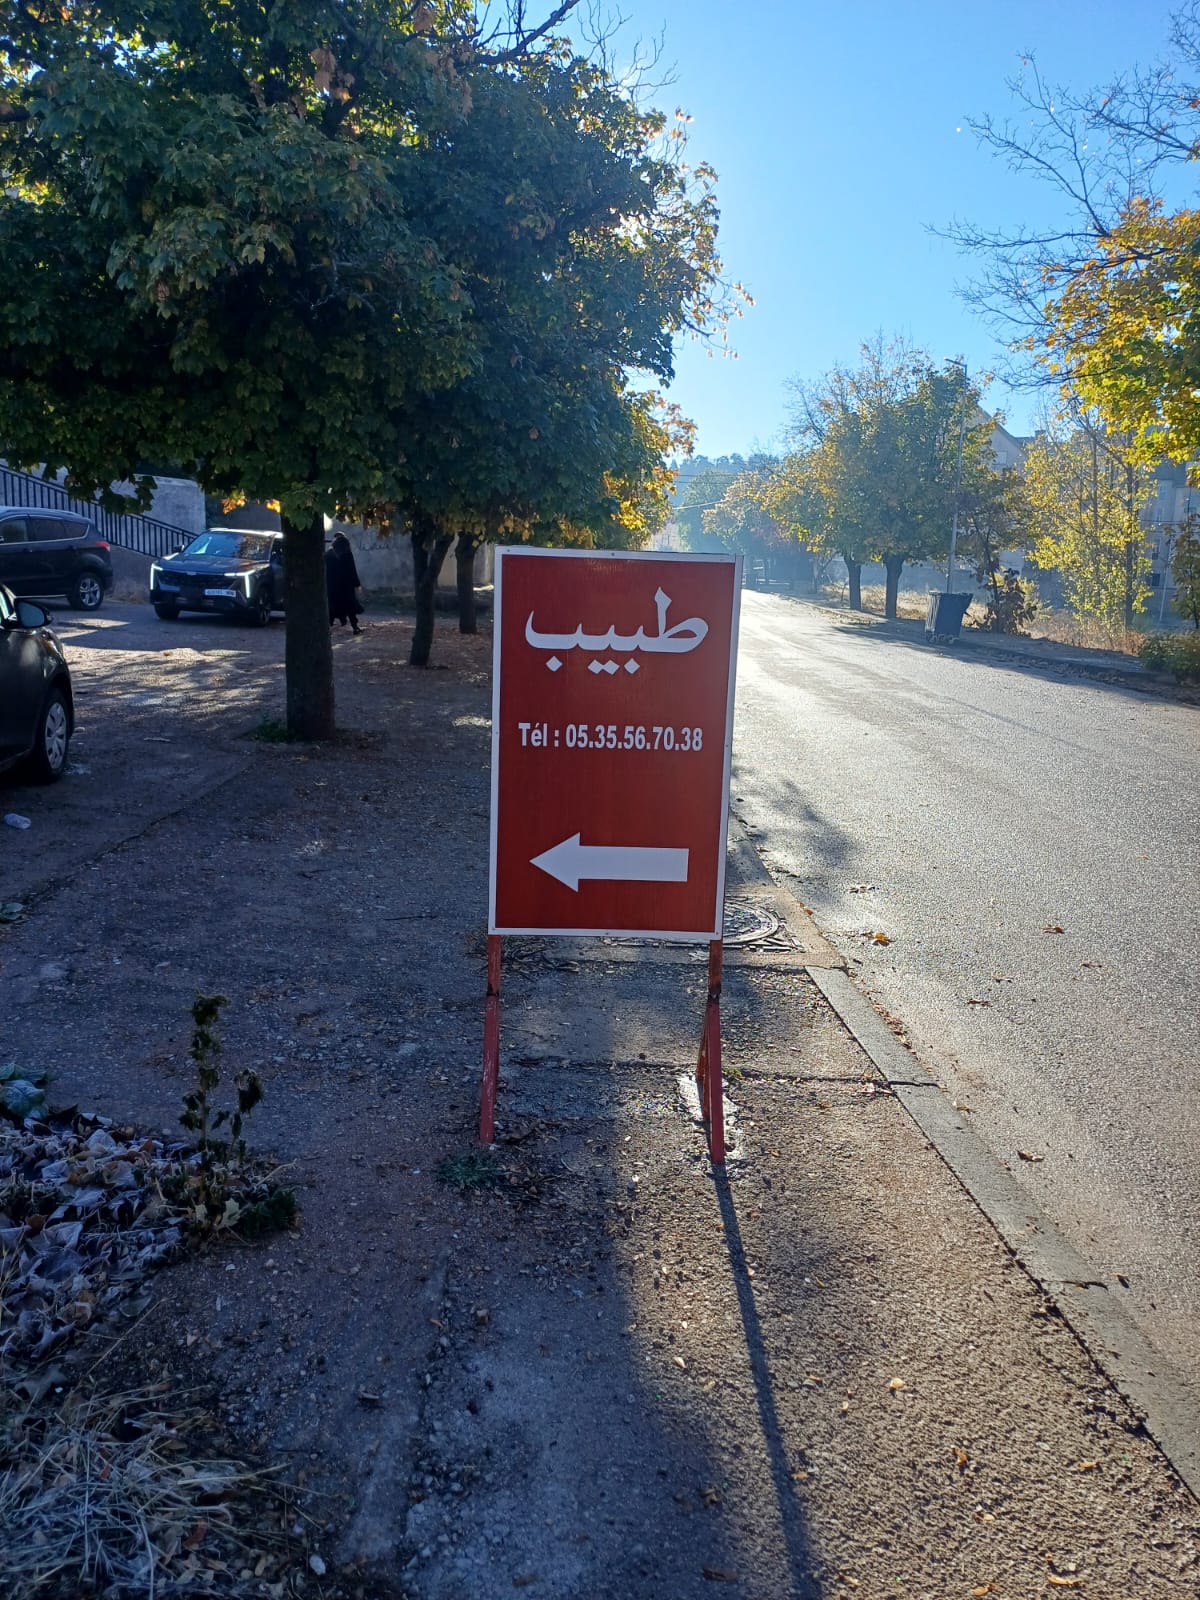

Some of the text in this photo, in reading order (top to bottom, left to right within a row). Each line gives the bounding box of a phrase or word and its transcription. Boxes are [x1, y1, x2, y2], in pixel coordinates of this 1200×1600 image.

[525, 586, 709, 675] طبيب
[518, 722, 548, 747] Tél
[565, 724, 703, 751] 05.35.56.70.38
